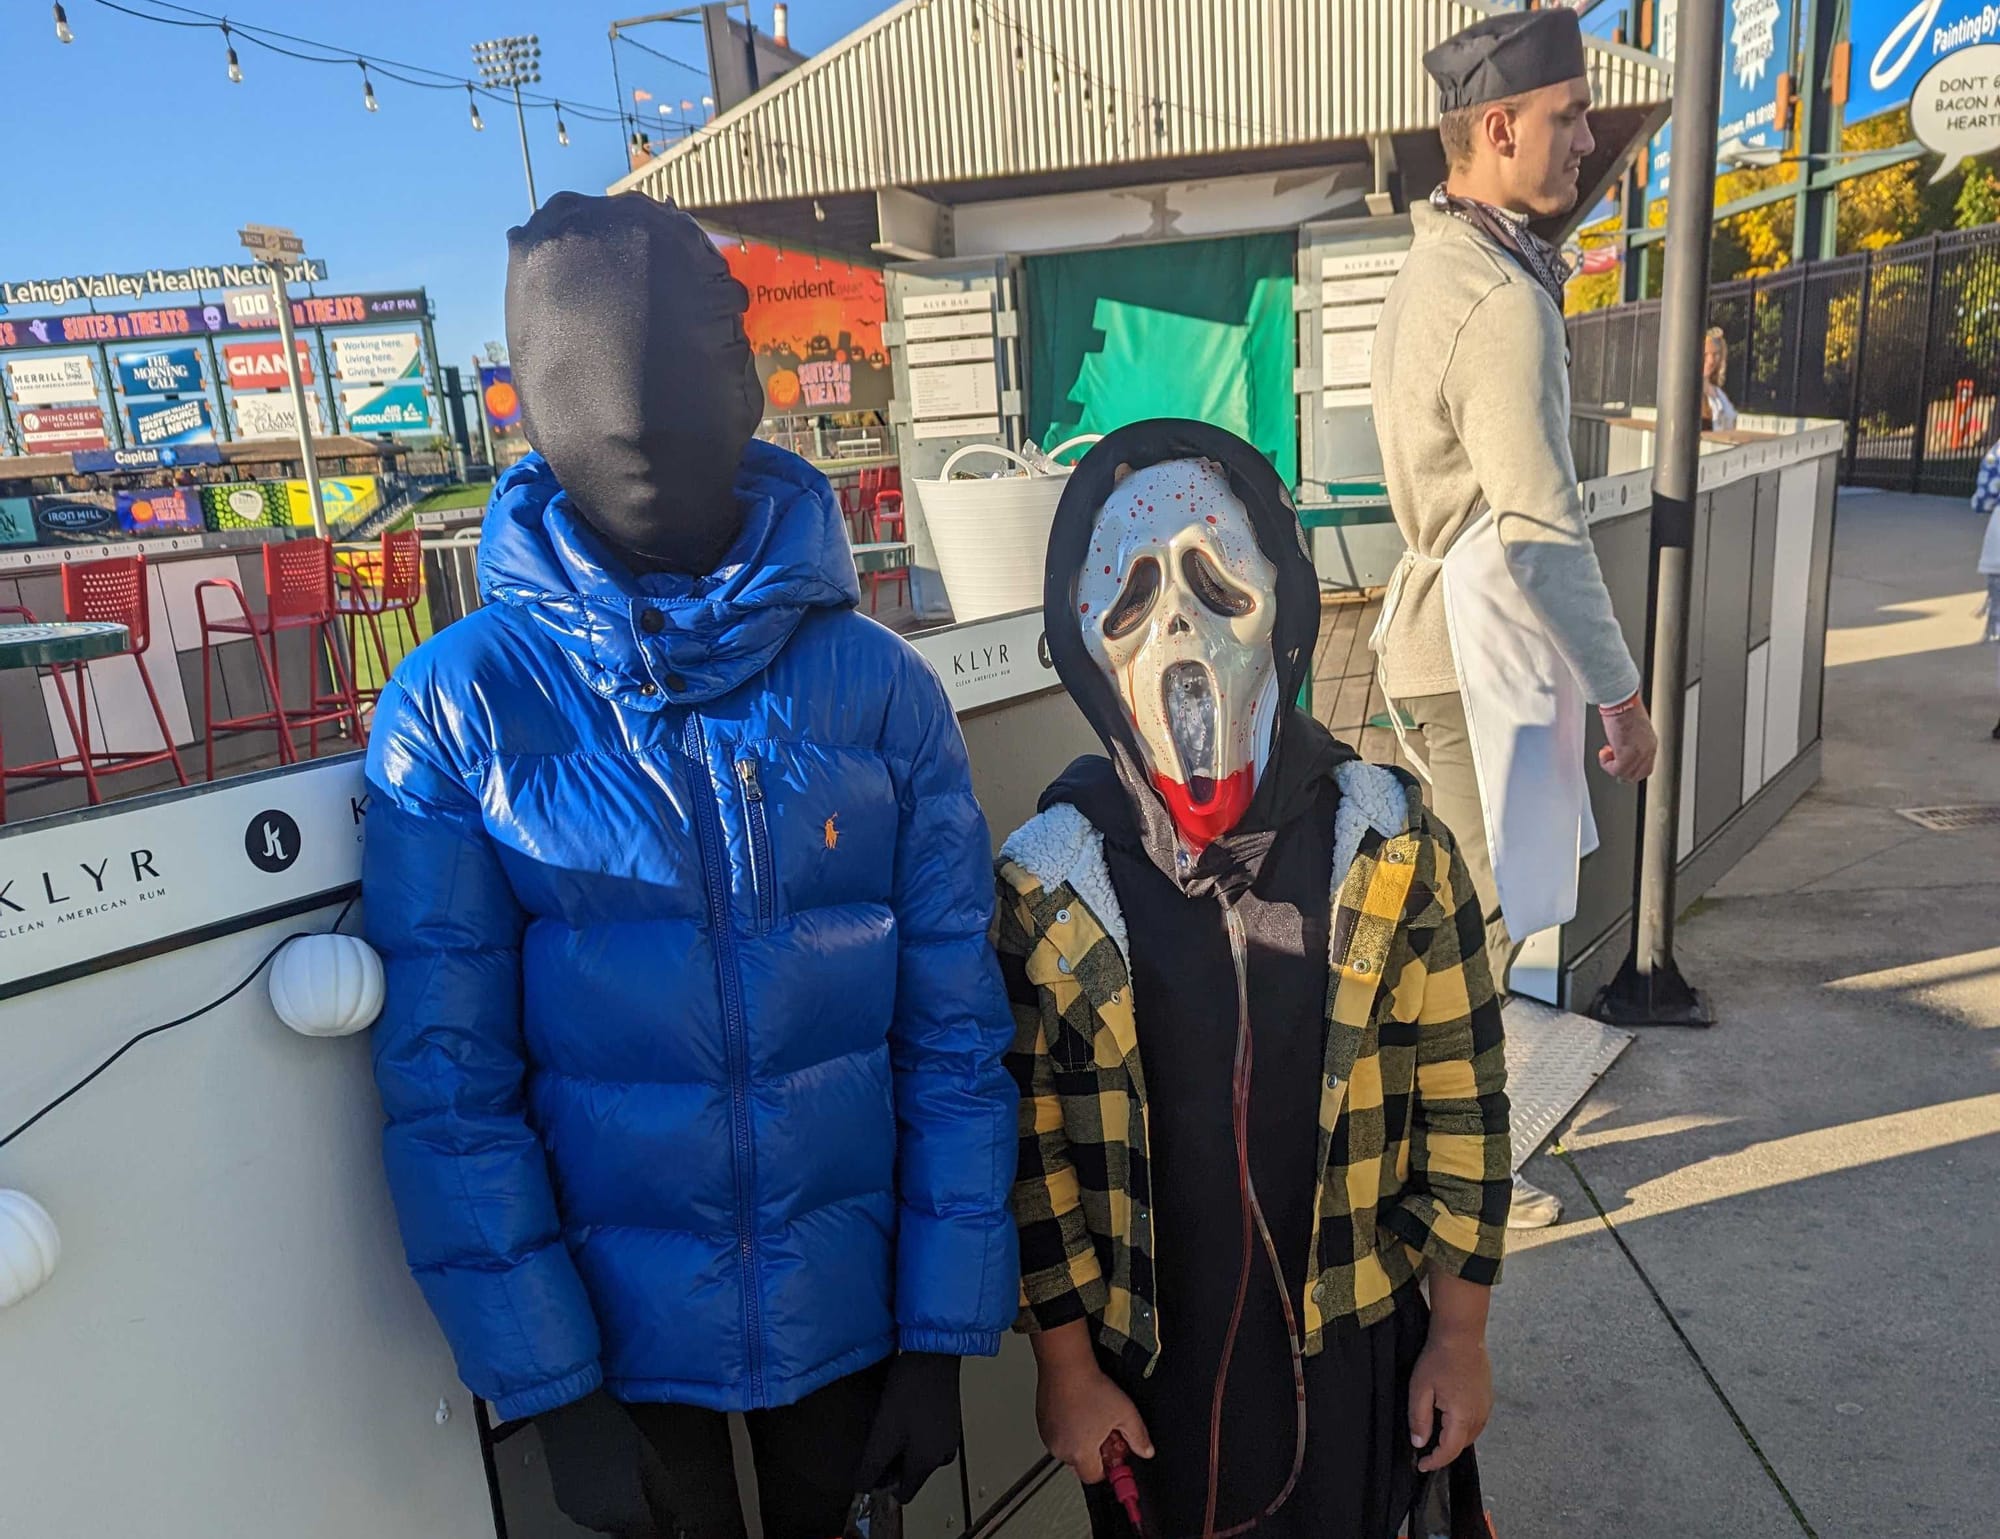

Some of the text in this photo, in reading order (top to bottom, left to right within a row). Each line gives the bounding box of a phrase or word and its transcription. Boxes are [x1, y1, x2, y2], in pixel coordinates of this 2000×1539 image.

[1742, 20, 1767, 46] HOTEL
[1735, 38, 1771, 68] PARTNER
[1940, 76, 1987, 93] DON'T
[1936, 96, 1988, 112] BACON
[5, 278, 77, 304] Lehigh
[77, 272, 144, 300] Valley
[147, 267, 219, 292] Health
[757, 279, 835, 304] Provident
[232, 294, 270, 317] 100
[303, 296, 366, 322] TREATS
[371, 300, 395, 312] 4:47
[397, 298, 417, 311] PM
[62, 314, 117, 341] SUITES
[129, 309, 189, 336] TREATS
[343, 338, 403, 352] Working here.
[147, 355, 170, 367] THE
[345, 352, 394, 364] Living here.
[14, 372, 64, 384] MERRILL
[133, 365, 189, 380] MORNING
[348, 365, 398, 377] Giving here.
[148, 377, 178, 391] CALL
[801, 382, 852, 407] TREATS
[39, 412, 97, 424] WIND CREEK
[384, 404, 401, 416] AIR
[139, 408, 200, 433] FIRST SOURCE
[352, 414, 402, 425] PRODUCTS
[141, 415, 203, 444] FOR NEWS
[114, 448, 159, 467] Capital
[48, 509, 102, 522] IRON HILL
[954, 645, 1008, 674] KLYR
[955, 679, 971, 688] CLEAN
[974, 672, 998, 682] AMERICAN
[0, 888, 166, 938] CLEAN AMERICAN RUM
